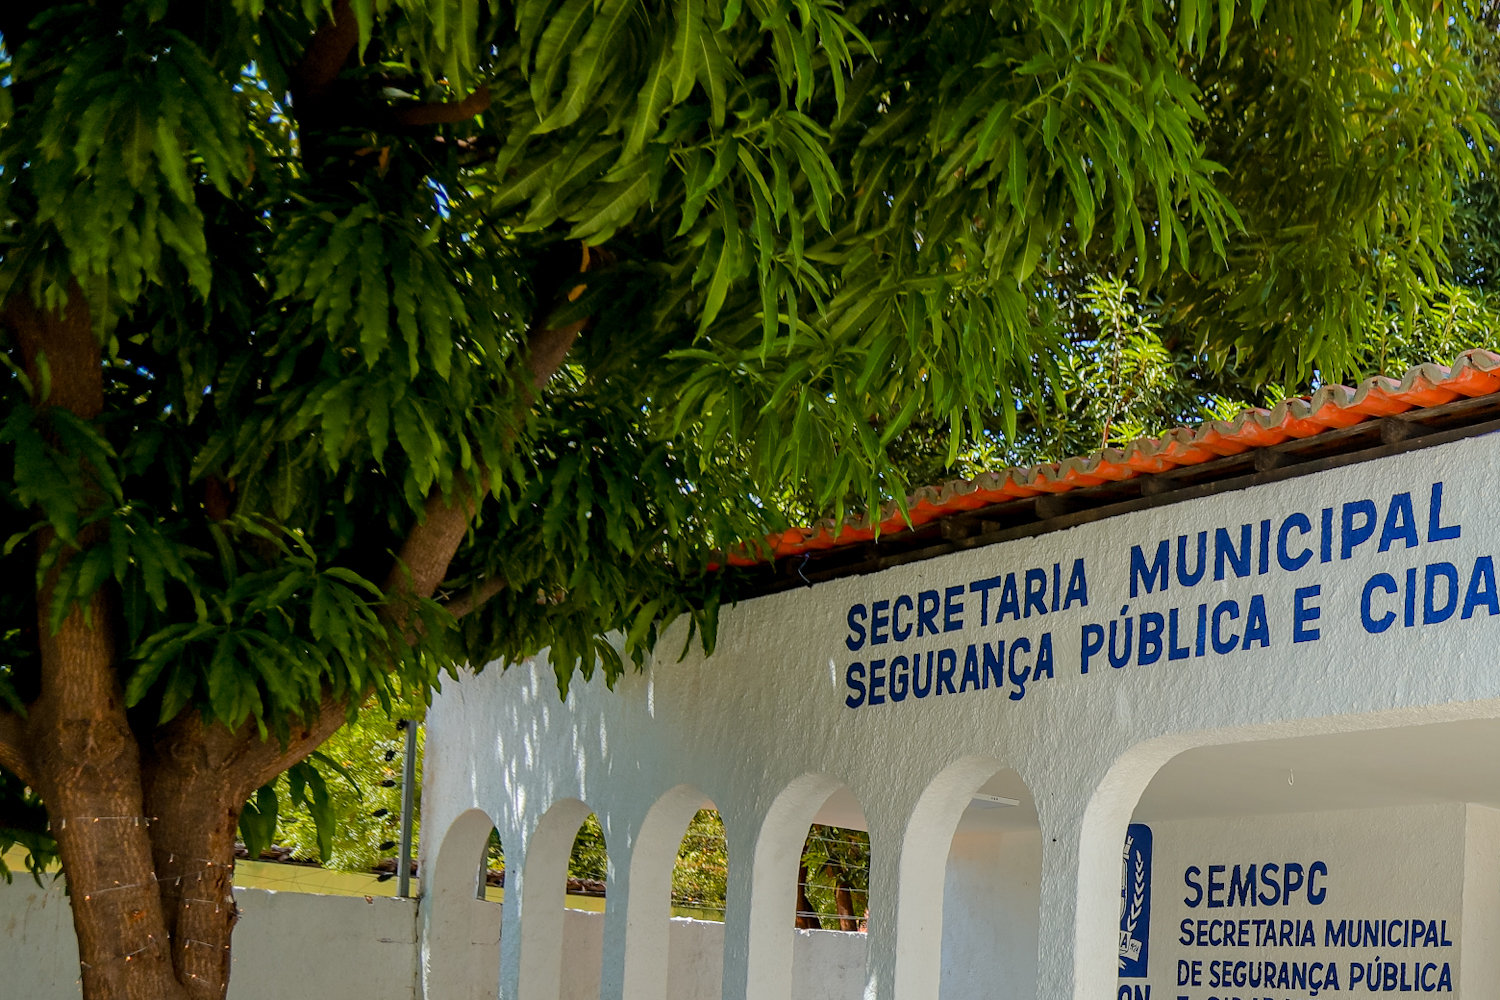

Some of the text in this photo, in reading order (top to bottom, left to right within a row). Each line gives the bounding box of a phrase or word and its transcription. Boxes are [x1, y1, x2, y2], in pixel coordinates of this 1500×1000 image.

[845, 558, 1088, 651] SECRETARIA
[1129, 481, 1461, 599] MUNICIPAL
[845, 632, 1054, 709] SEGURANÇA
[1080, 594, 1270, 675] PÚBLICA
[1293, 584, 1321, 644] E
[1184, 860, 1328, 908] SEMSPC
[1178, 918, 1453, 948] SECRETARIA MUNICIPAL
[1177, 955, 1453, 997] DE SEGURANÇA PÚBLICA
